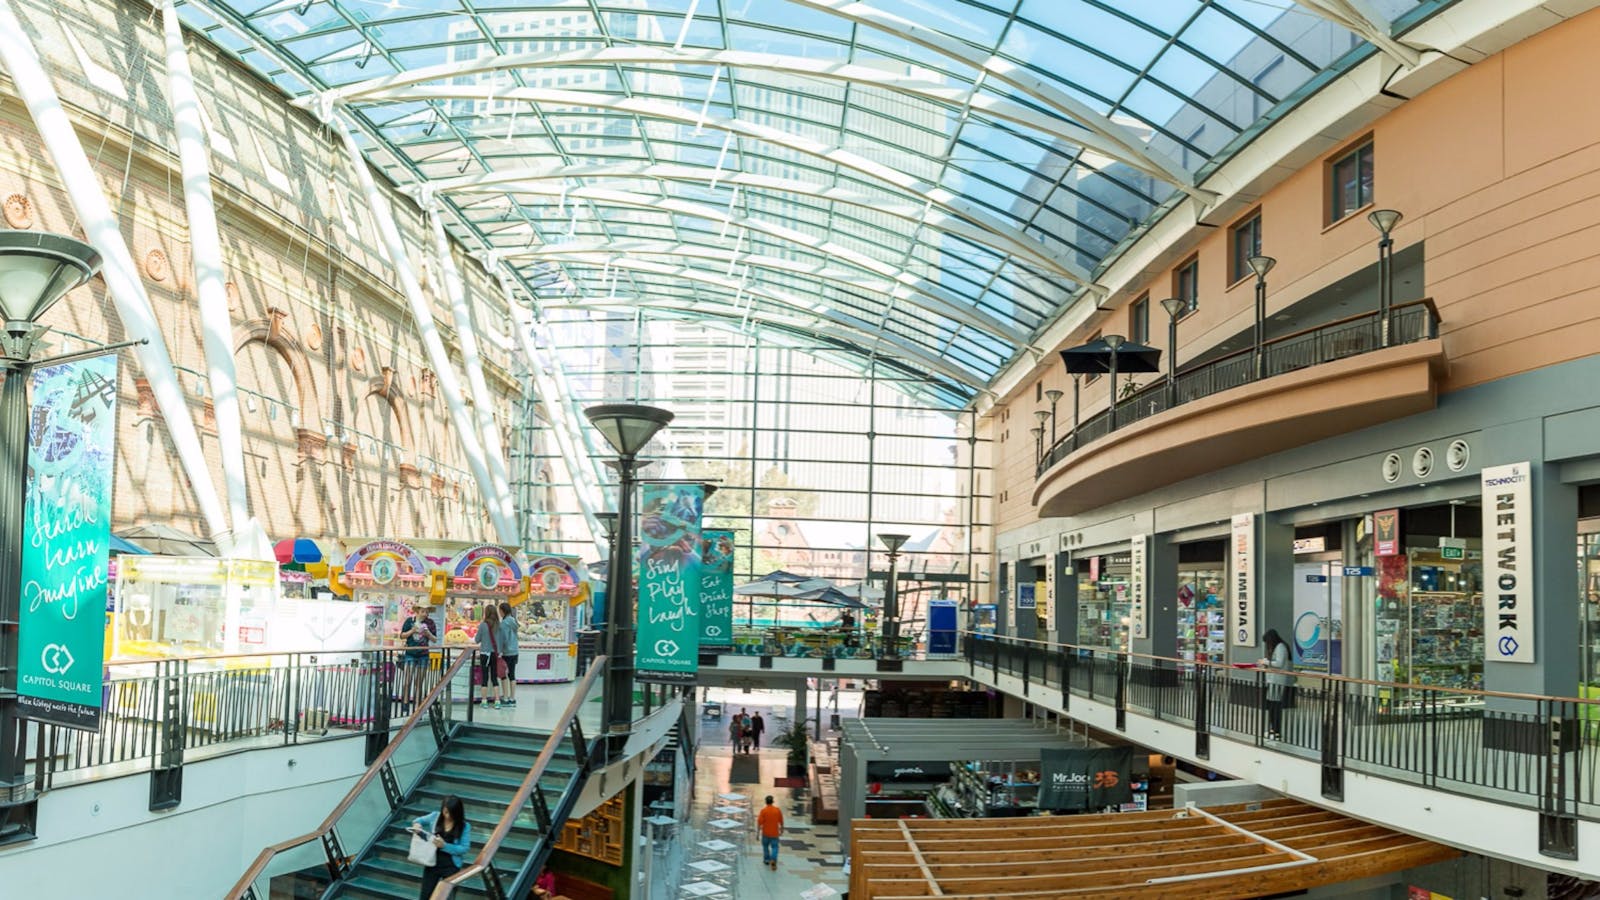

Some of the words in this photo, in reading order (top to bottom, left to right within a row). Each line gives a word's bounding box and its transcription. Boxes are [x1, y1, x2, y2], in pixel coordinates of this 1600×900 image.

[45, 540, 99, 570] Learn
[1496, 493, 1517, 630] NETWORK
[646, 558, 680, 585] Sing
[702, 575, 721, 588] Eat
[24, 566, 108, 620] Imagine
[647, 580, 685, 606] Play
[648, 597, 697, 631] Laugh
[23, 675, 56, 687] CAPITOL
[58, 680, 92, 693] SQUARE
